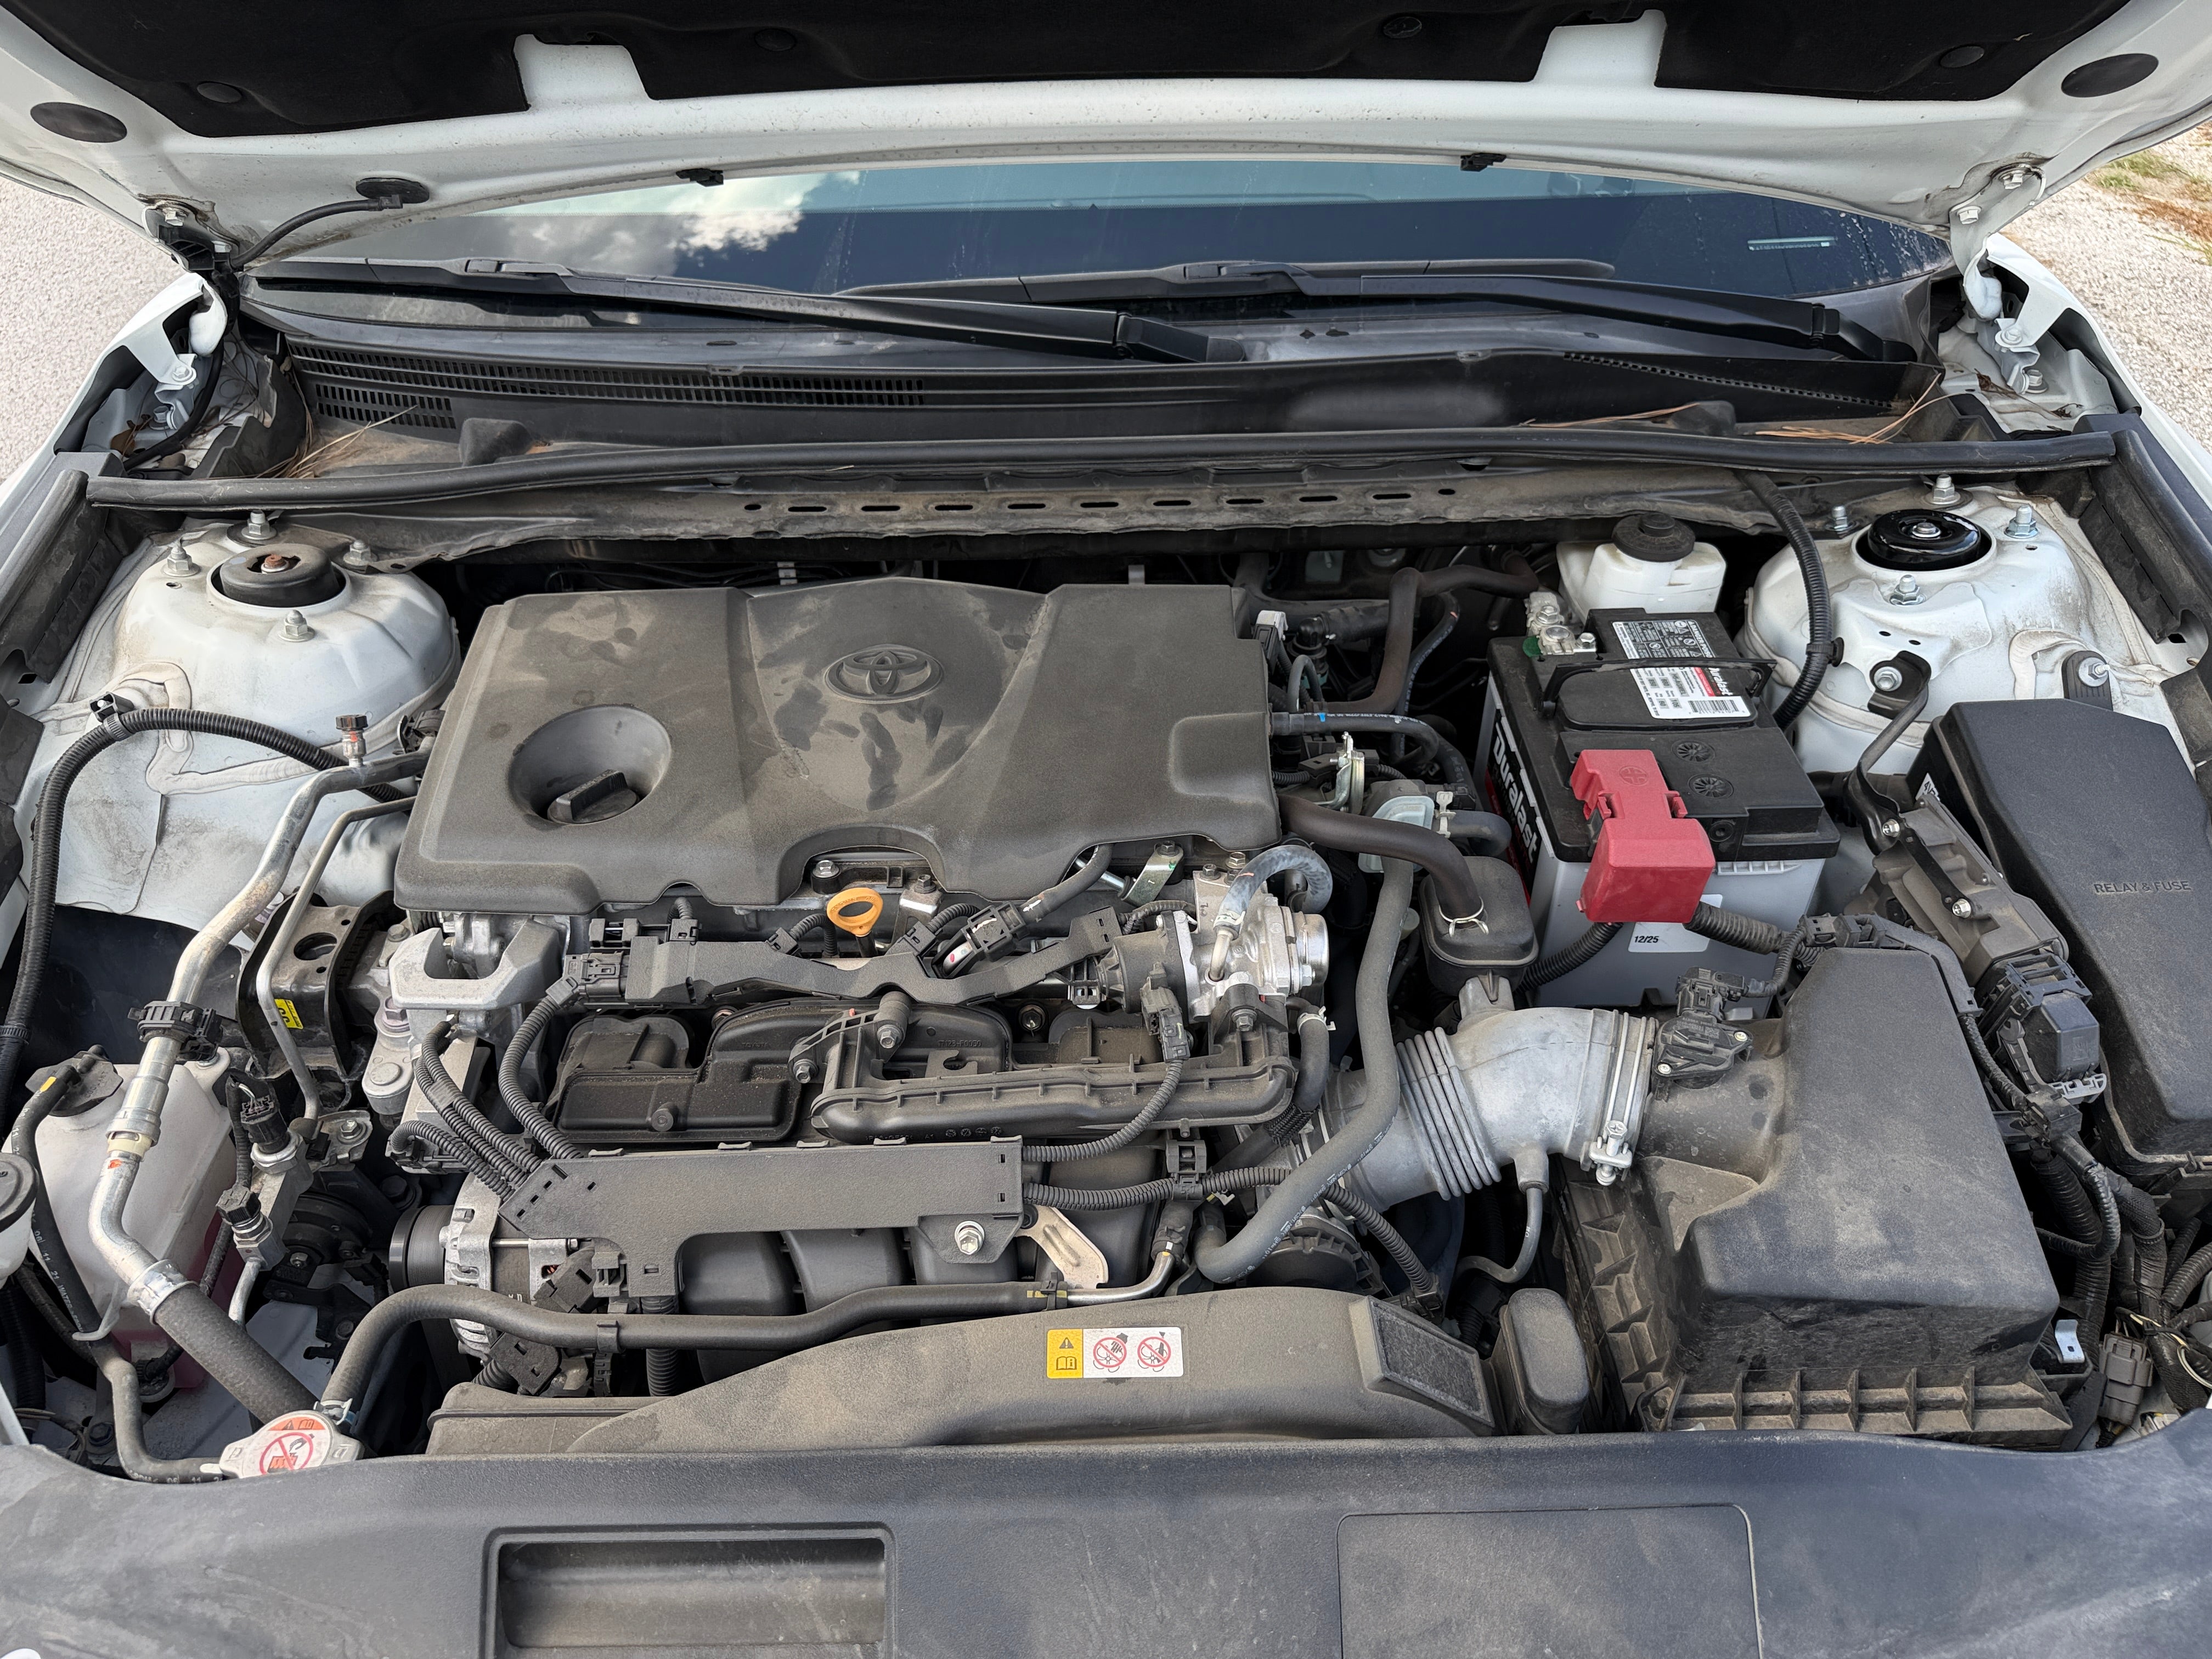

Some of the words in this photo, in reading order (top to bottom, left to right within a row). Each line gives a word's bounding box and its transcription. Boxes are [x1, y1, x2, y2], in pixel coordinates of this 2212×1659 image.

[1708, 667, 1733, 696] uralast
[1493, 723, 1538, 863] Duralast
[2094, 882, 2138, 893] RELAY
[2141, 882, 2150, 891] &
[2153, 881, 2192, 891] FUSE
